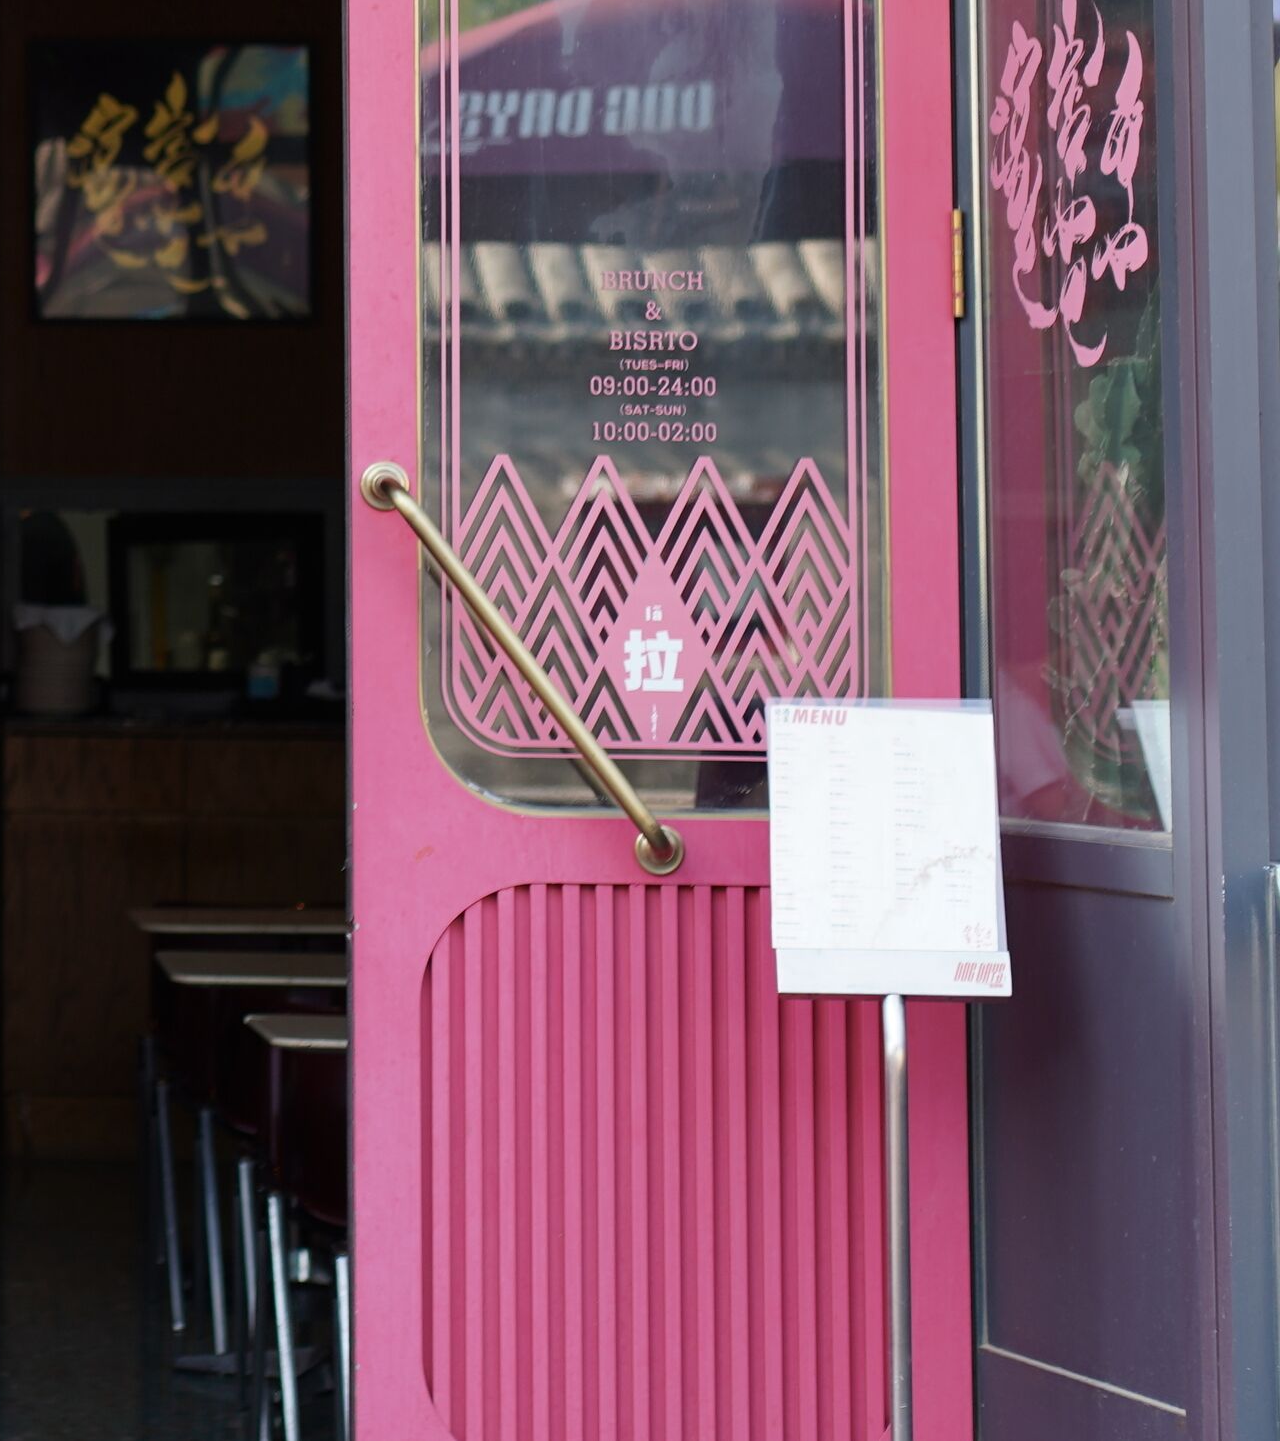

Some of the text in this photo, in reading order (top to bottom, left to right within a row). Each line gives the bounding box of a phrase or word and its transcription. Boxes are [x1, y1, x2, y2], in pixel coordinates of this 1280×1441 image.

[601, 270, 704, 291] BRUNCH
[644, 300, 662, 320] &
[609, 330, 699, 352] BISRTO
[590, 375, 717, 397] 09:00-24:00
[619, 403, 687, 417] (SAT-SUN)
[592, 421, 718, 443] 10:00-02:00
[623, 628, 684, 692] 拉
[792, 708, 848, 726] MENU
